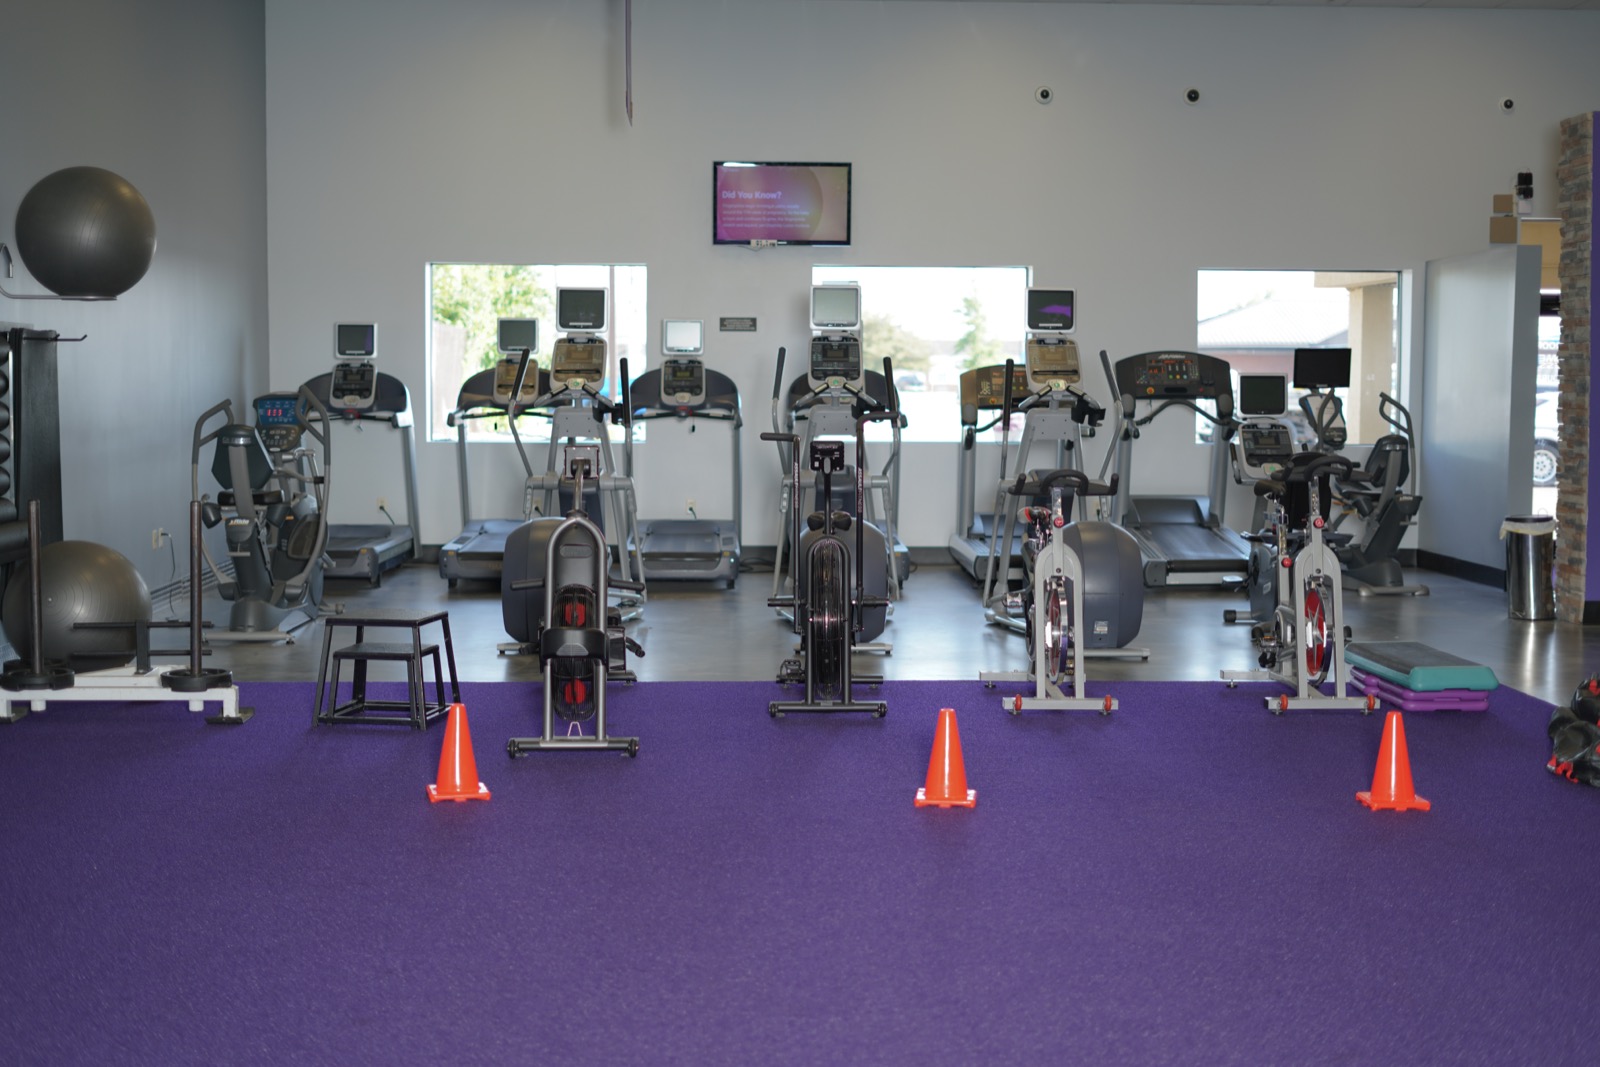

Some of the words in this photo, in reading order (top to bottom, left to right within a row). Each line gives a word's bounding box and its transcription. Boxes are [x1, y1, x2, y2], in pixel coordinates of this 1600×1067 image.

[722, 191, 736, 199] Did
[738, 191, 752, 199] You
[755, 191, 782, 199] Know?
